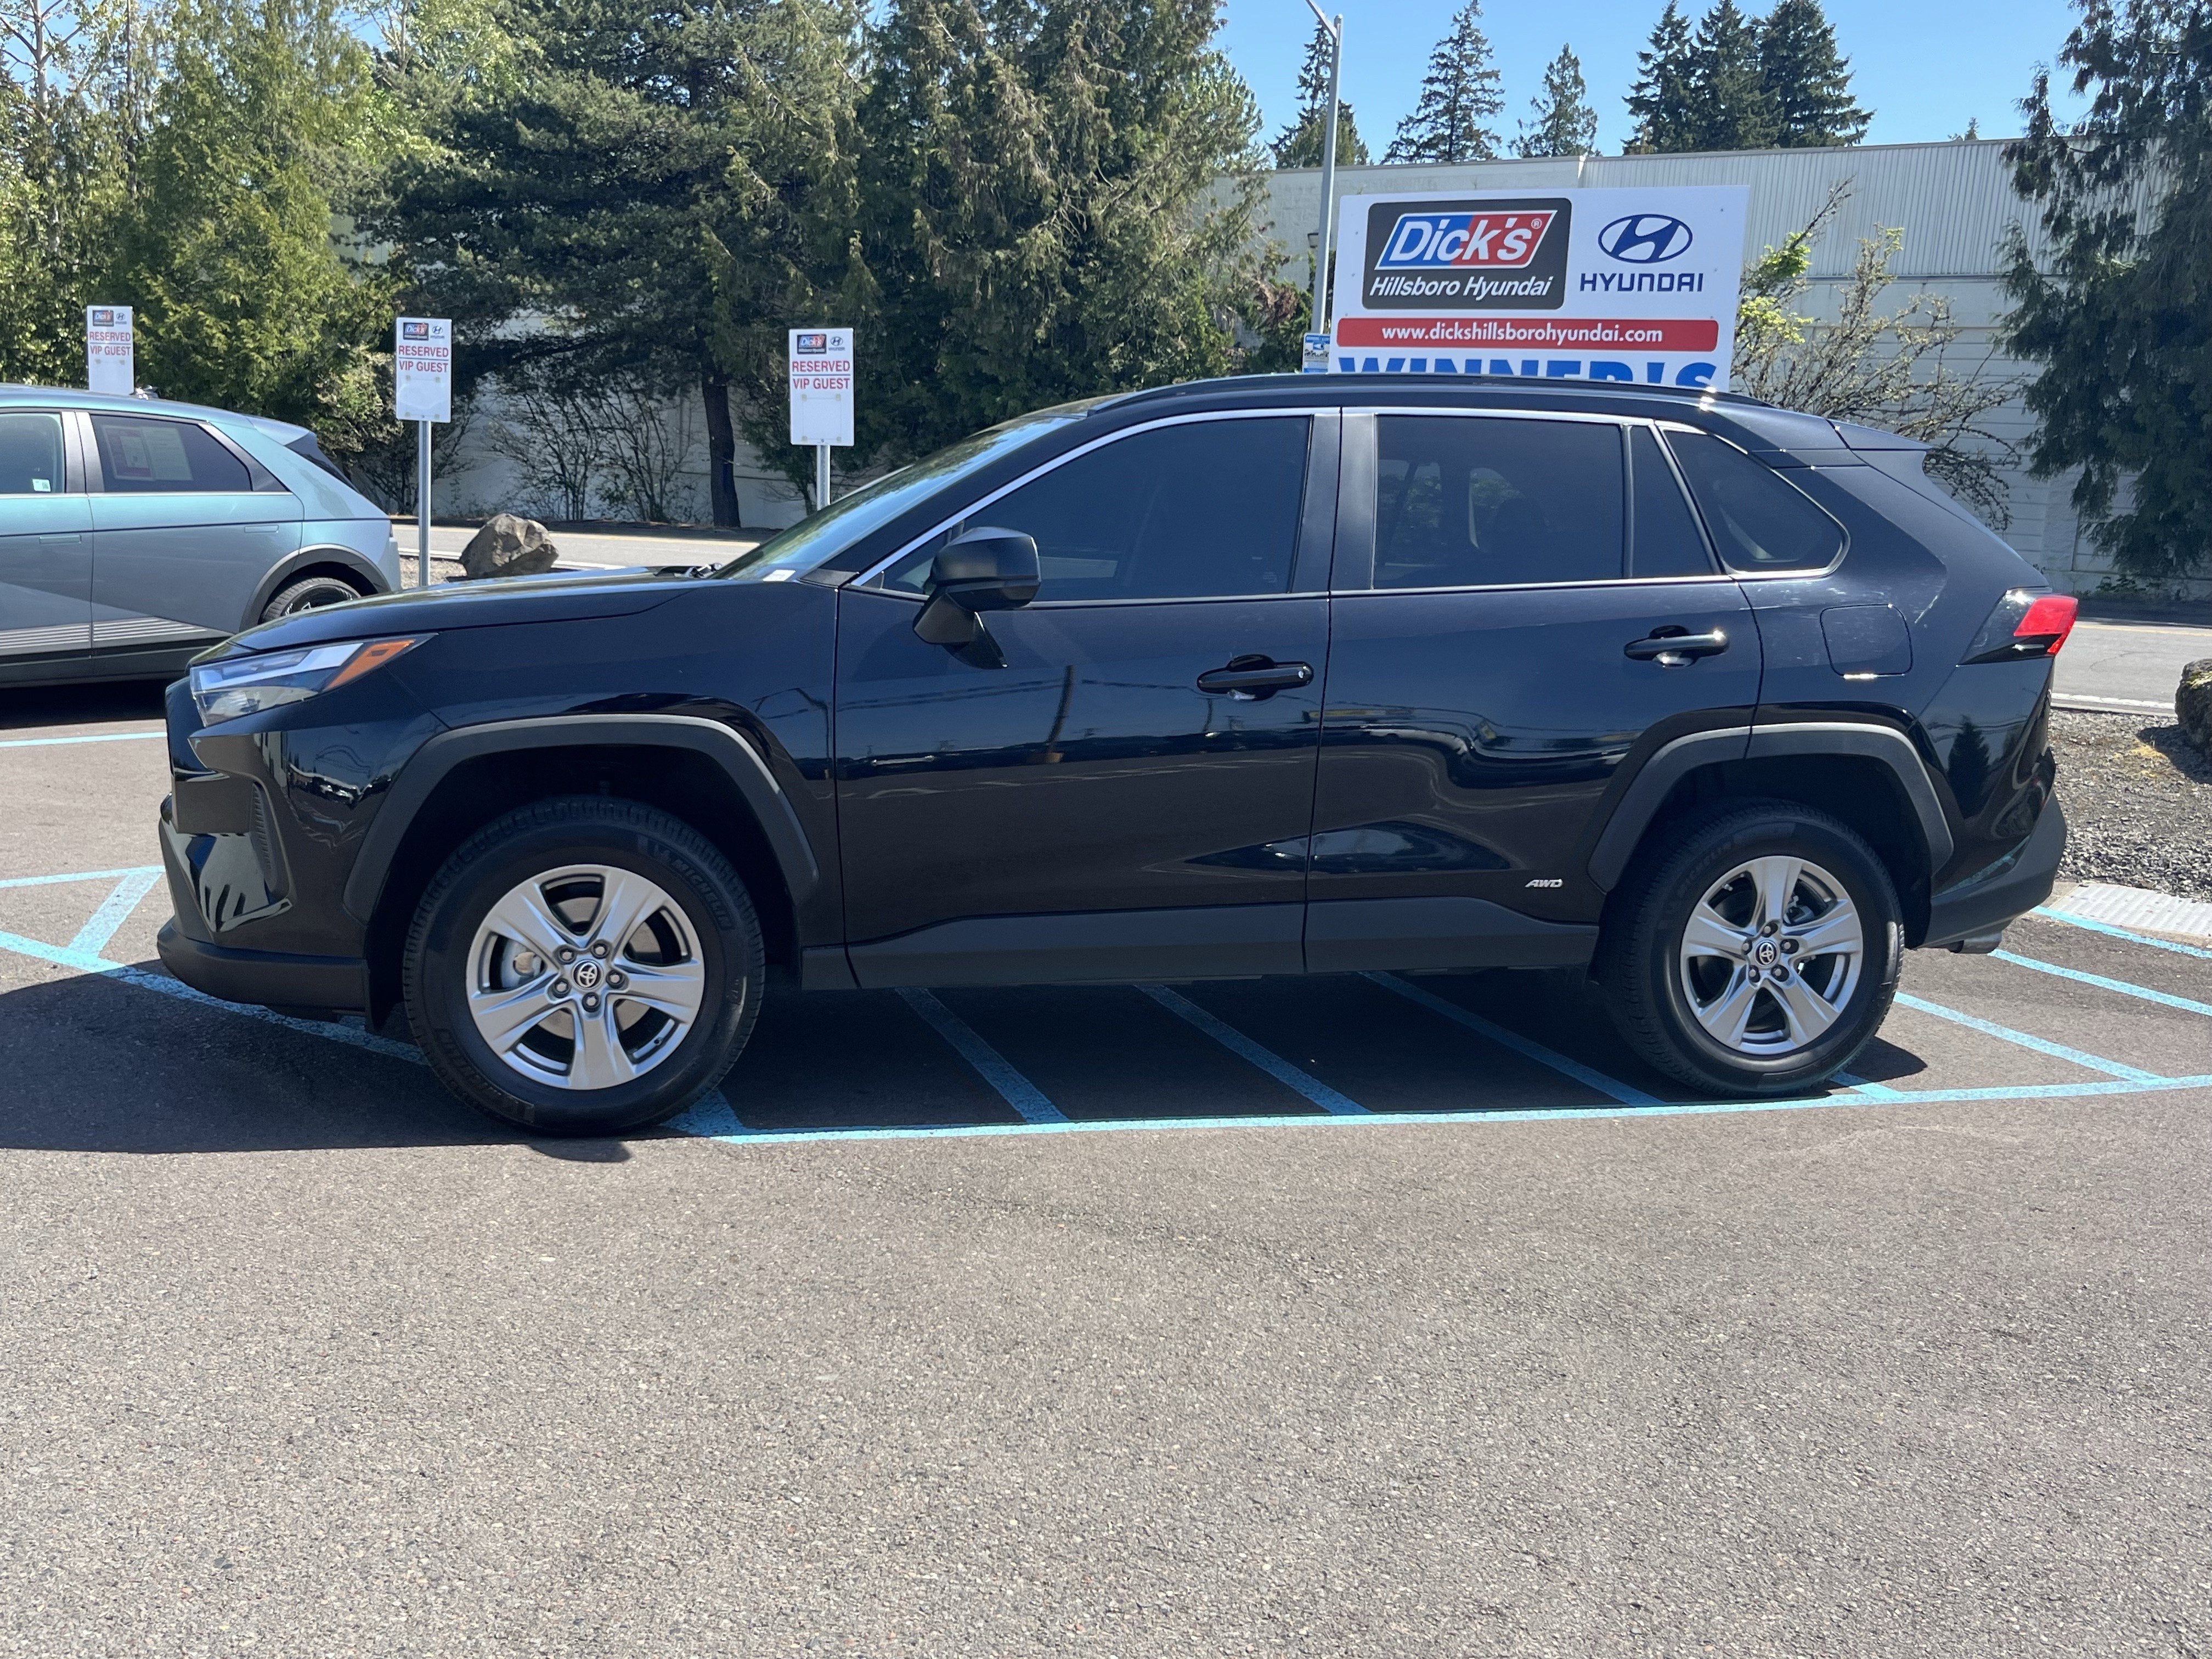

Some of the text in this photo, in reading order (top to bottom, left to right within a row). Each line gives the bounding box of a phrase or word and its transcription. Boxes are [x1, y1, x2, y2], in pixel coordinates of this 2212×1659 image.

[1389, 218, 1532, 261] Dick's
[1369, 275, 1554, 301] Hillsboro Hyundai
[1579, 273, 1704, 292] HYUNDAI
[89, 331, 131, 342] RESERVED
[1382, 321, 1663, 346] www.dickshillsborohyundai.com
[90, 346, 131, 356] VIP GUEST
[398, 345, 449, 357] RESERVED
[399, 360, 448, 373] VIP GUEST
[792, 360, 850, 372] RESERVED
[793, 378, 850, 390] VIP GUEST
[1525, 878, 1562, 888] AWD
